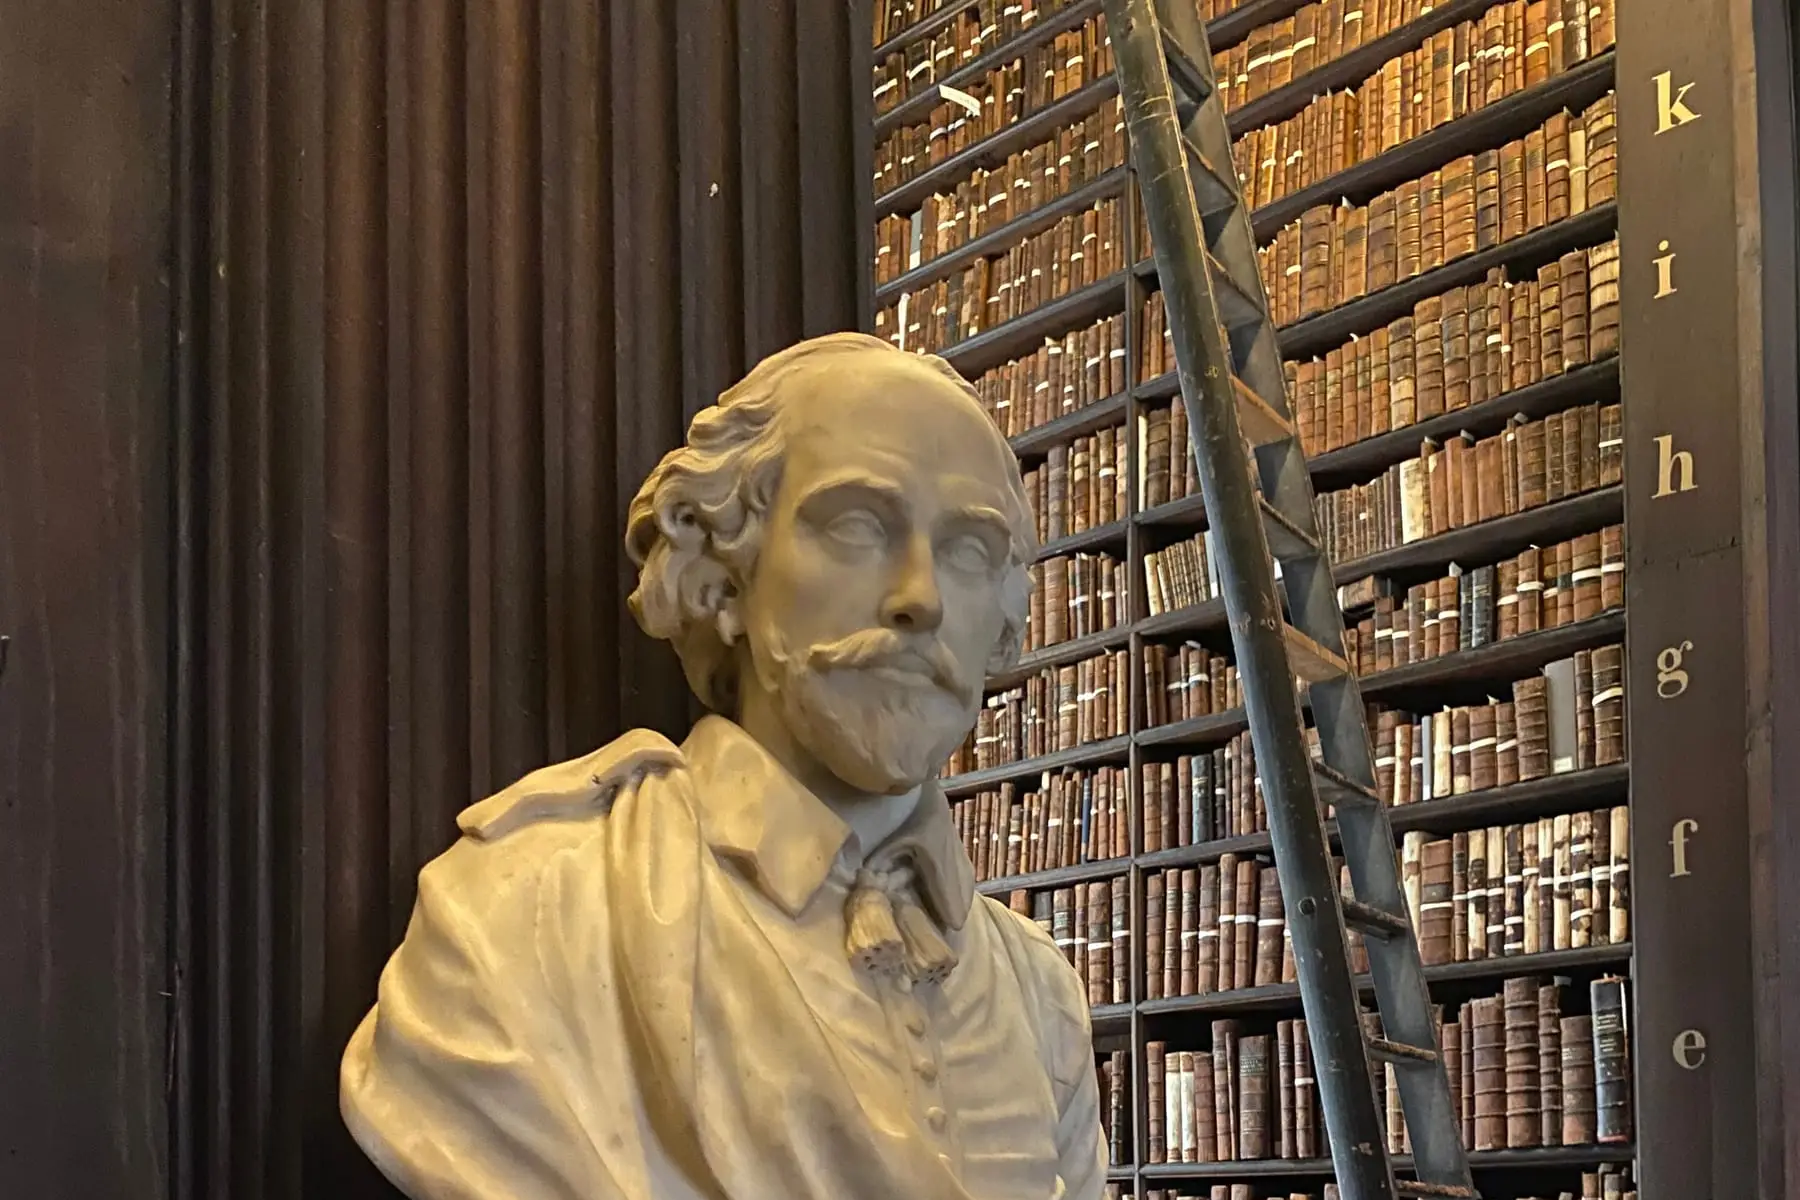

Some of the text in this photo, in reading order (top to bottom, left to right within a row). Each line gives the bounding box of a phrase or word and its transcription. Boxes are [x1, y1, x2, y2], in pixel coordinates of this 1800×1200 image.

[1651, 70, 1702, 136] k
[1652, 240, 1677, 299] i
[1651, 434, 1698, 499] h
[1657, 640, 1694, 699] g
[1668, 819, 1699, 878] f
[1672, 1029, 1706, 1070] e
